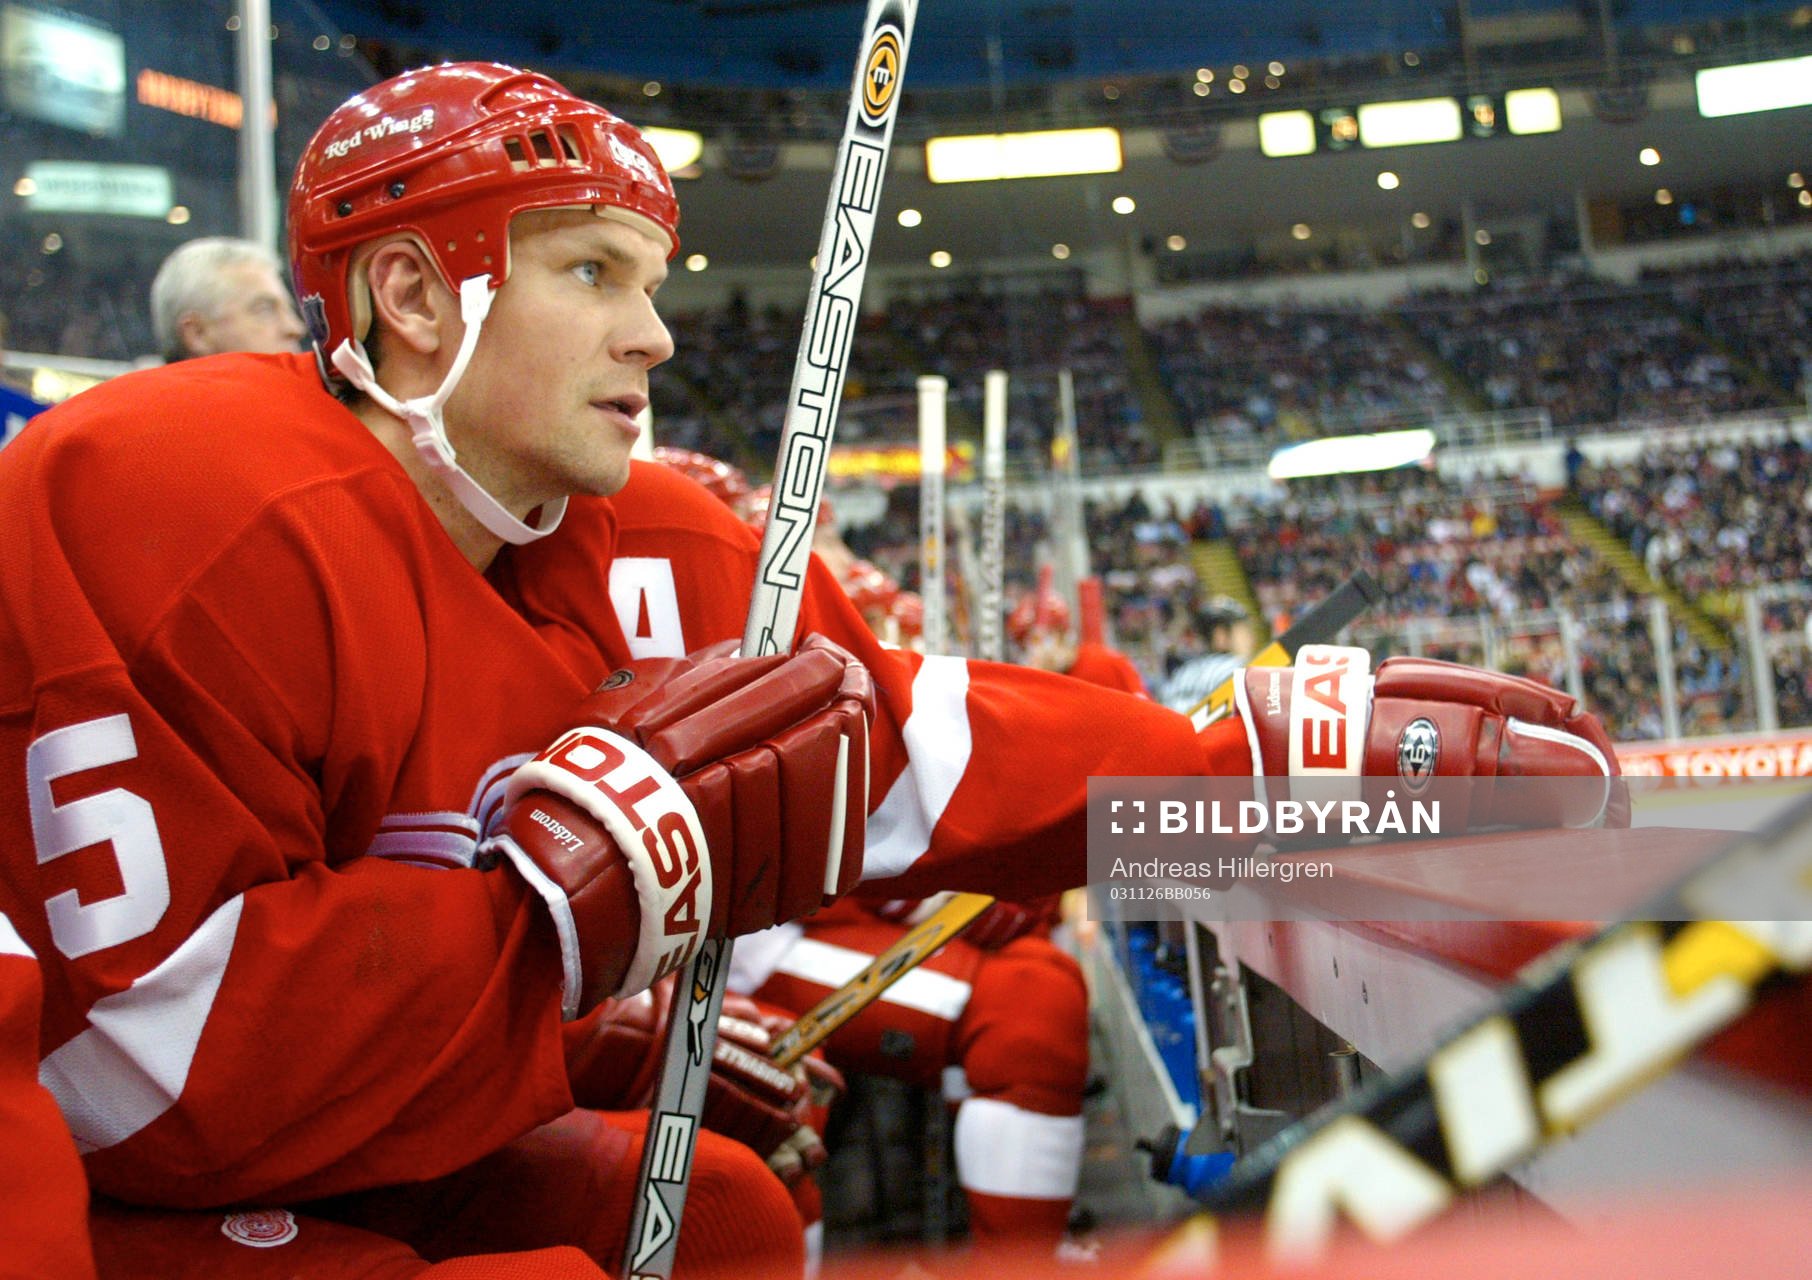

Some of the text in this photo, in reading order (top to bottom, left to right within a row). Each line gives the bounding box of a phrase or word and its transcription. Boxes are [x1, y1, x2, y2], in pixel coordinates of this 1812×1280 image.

[324, 108, 434, 160] Red Wings
[763, 140, 884, 591] EASTON
[608, 556, 687, 661] A
[26, 713, 170, 960] 5
[530, 808, 584, 852] Lidstrom
[629, 1111, 696, 1280] EA
